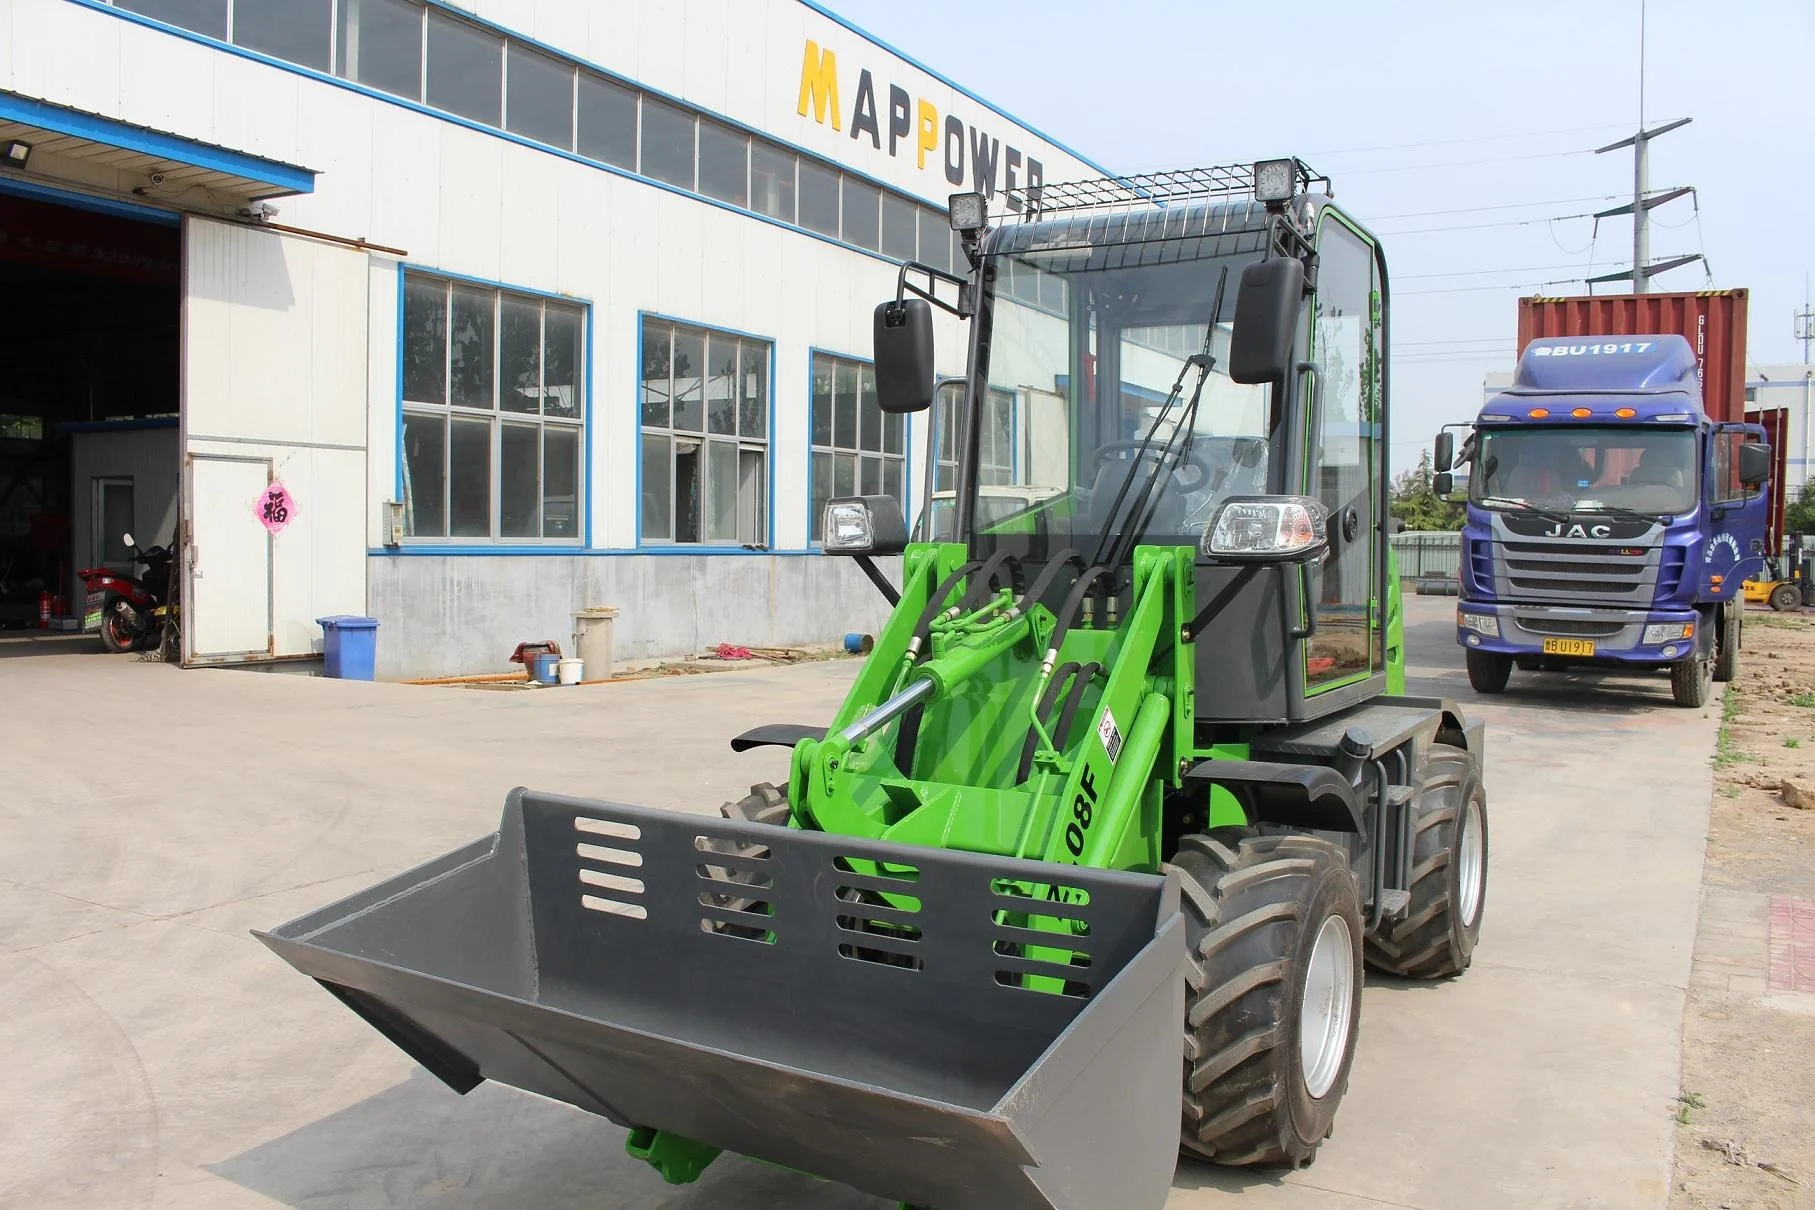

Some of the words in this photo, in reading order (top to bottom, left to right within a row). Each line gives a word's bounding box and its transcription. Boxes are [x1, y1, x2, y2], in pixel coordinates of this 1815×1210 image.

[797, 38, 1043, 222] MAPPOWER
[1697, 314, 1705, 355] GLDU
[263, 491, 288, 523] 福
[1545, 524, 1611, 539] JAC
[1058, 762, 1098, 866] 08F
